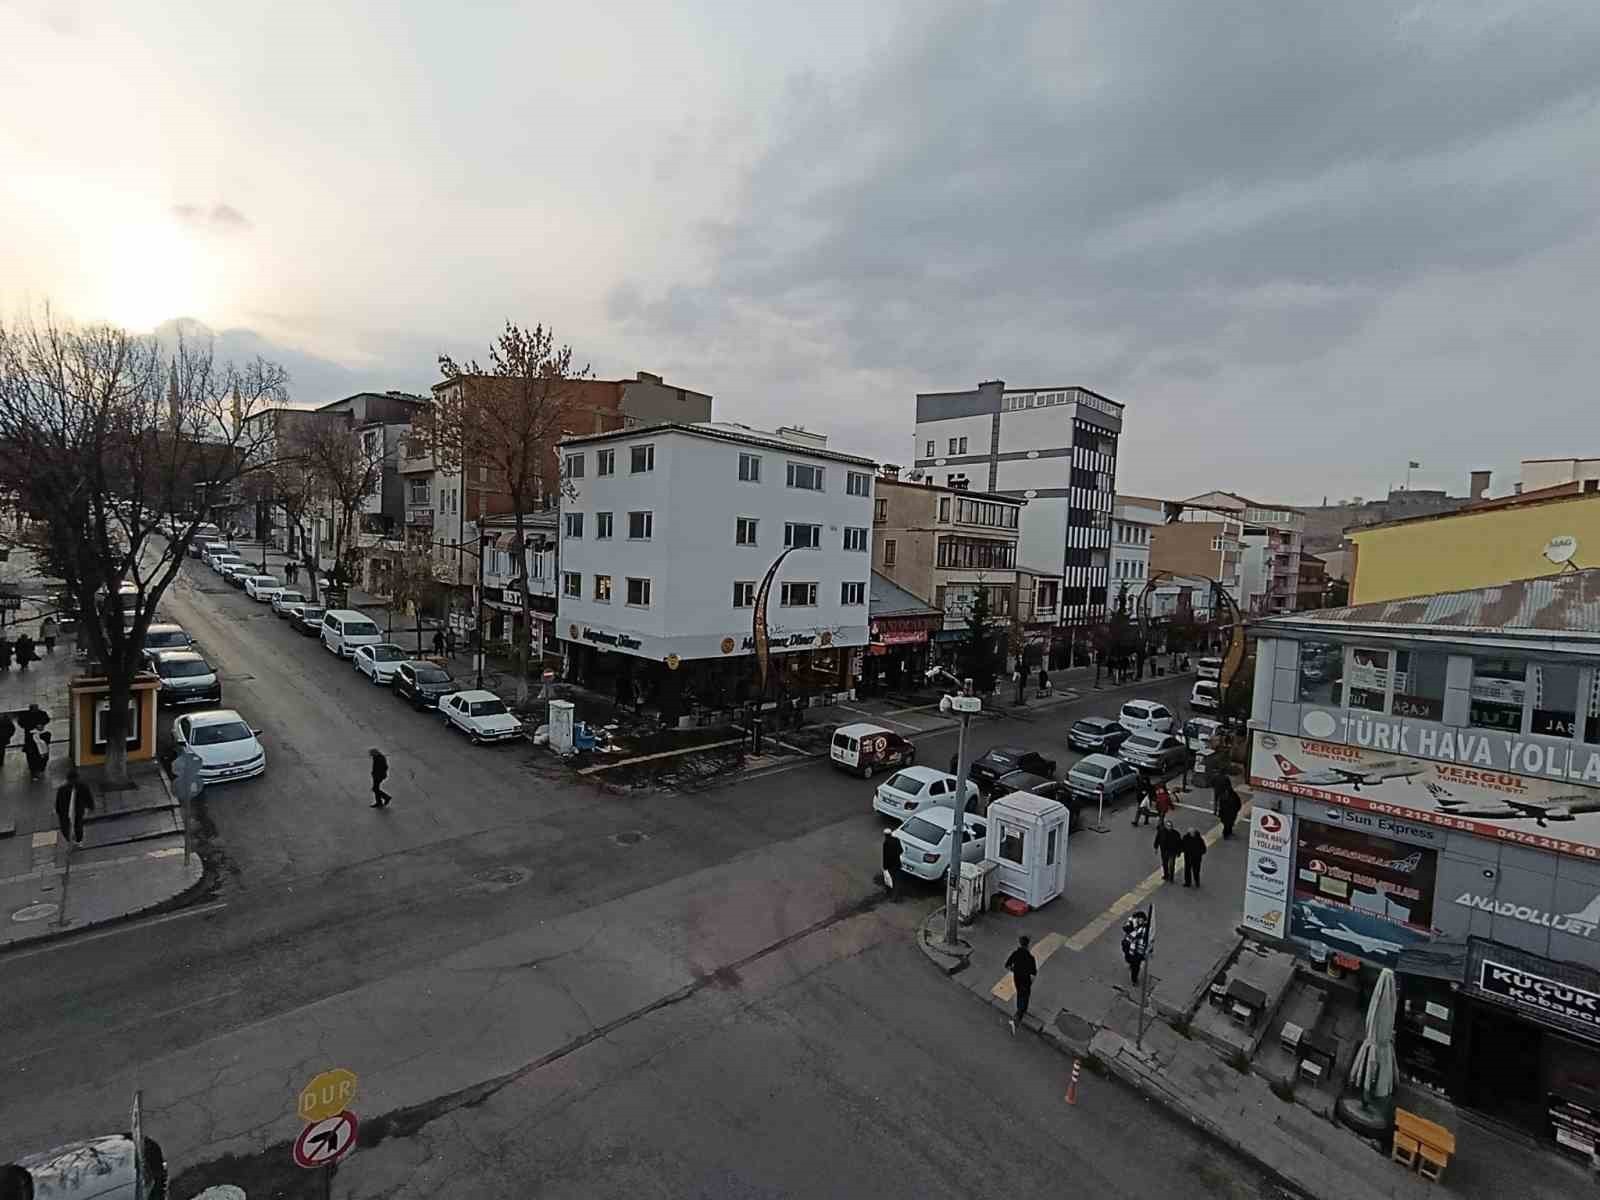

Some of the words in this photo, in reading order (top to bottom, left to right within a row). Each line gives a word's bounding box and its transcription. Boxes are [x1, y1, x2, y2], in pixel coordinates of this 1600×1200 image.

[1341, 715, 1410, 753] TÜRK
[1419, 729, 1493, 766] HAVA
[1345, 810, 1372, 826] Sun
[1378, 818, 1434, 841] Express
[1369, 801, 1401, 815] 0474
[1405, 809, 1431, 822] 212
[1496, 828, 1536, 844] 0474
[1539, 838, 1571, 851] 212
[1574, 845, 1597, 858] 40
[1455, 892, 1598, 937] ANADOLUJET
[1492, 967, 1597, 1011] KÜÇÜK
[304, 1080, 351, 1112] DUR
